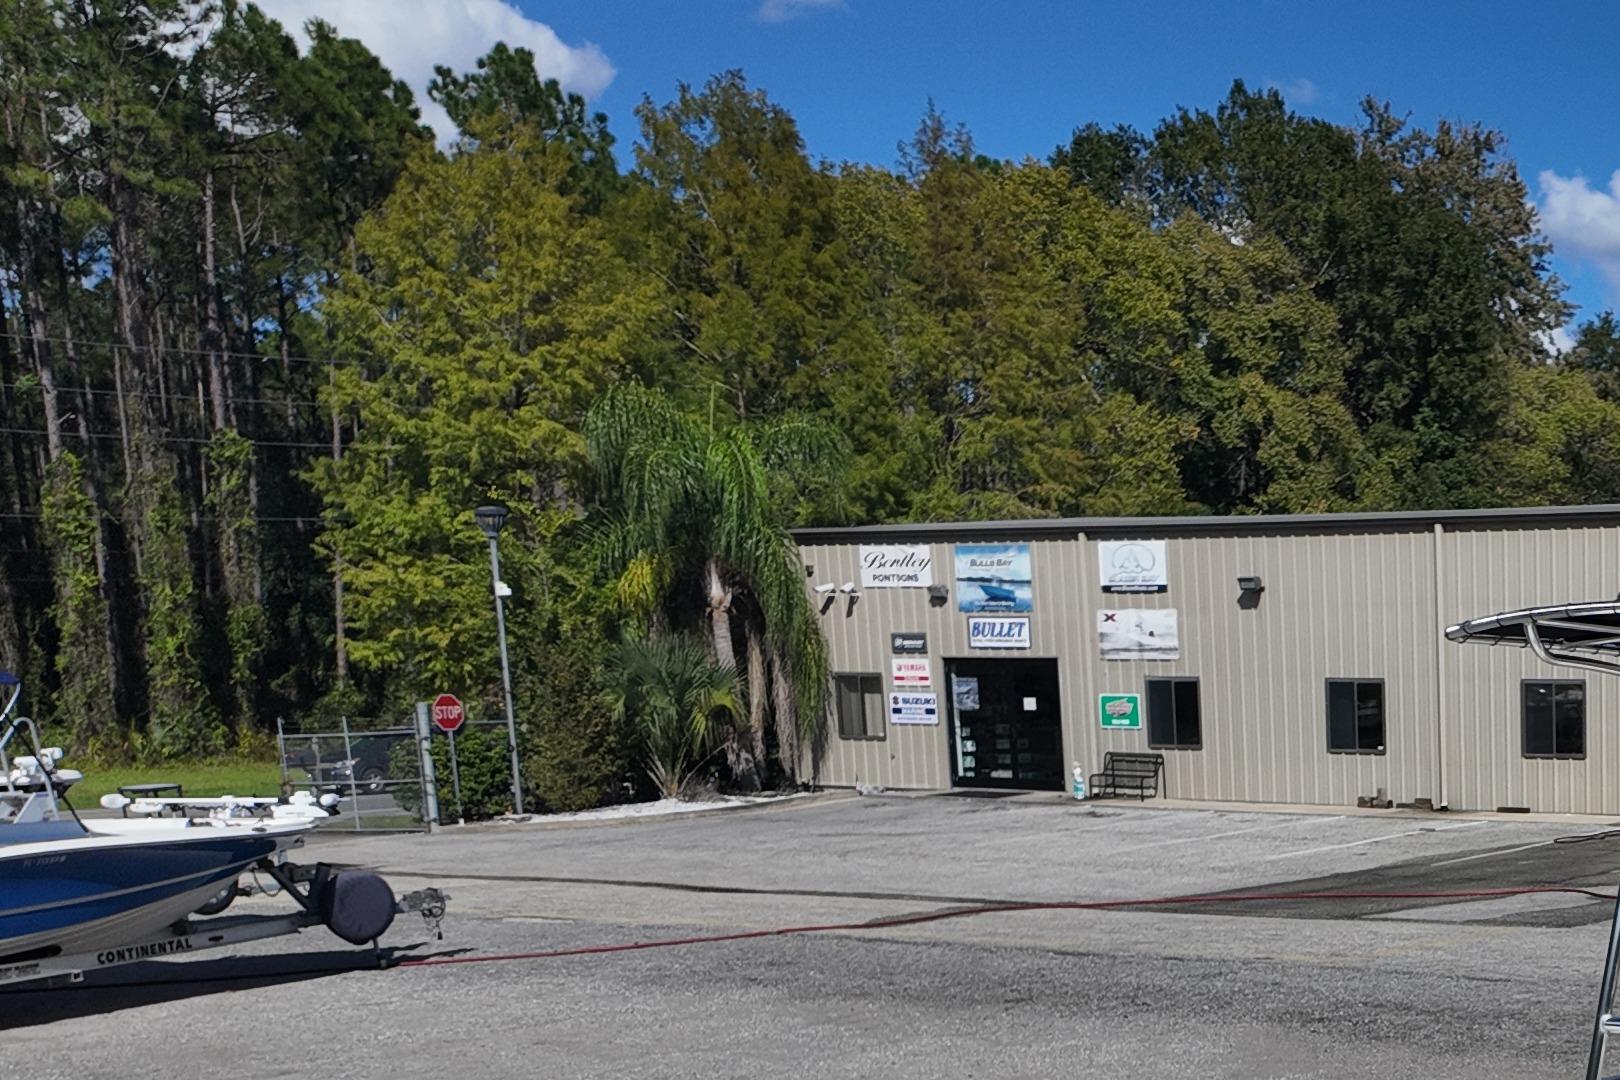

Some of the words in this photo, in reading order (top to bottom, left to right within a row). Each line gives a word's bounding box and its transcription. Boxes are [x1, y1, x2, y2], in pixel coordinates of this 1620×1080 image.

[864, 551, 931, 572] Bentley
[873, 573, 919, 583] PONTOONS
[972, 622, 1026, 638] BULLET
[902, 697, 936, 705] SUZUKI
[436, 705, 461, 719] STOP
[97, 938, 193, 965] CONTINENTAL
